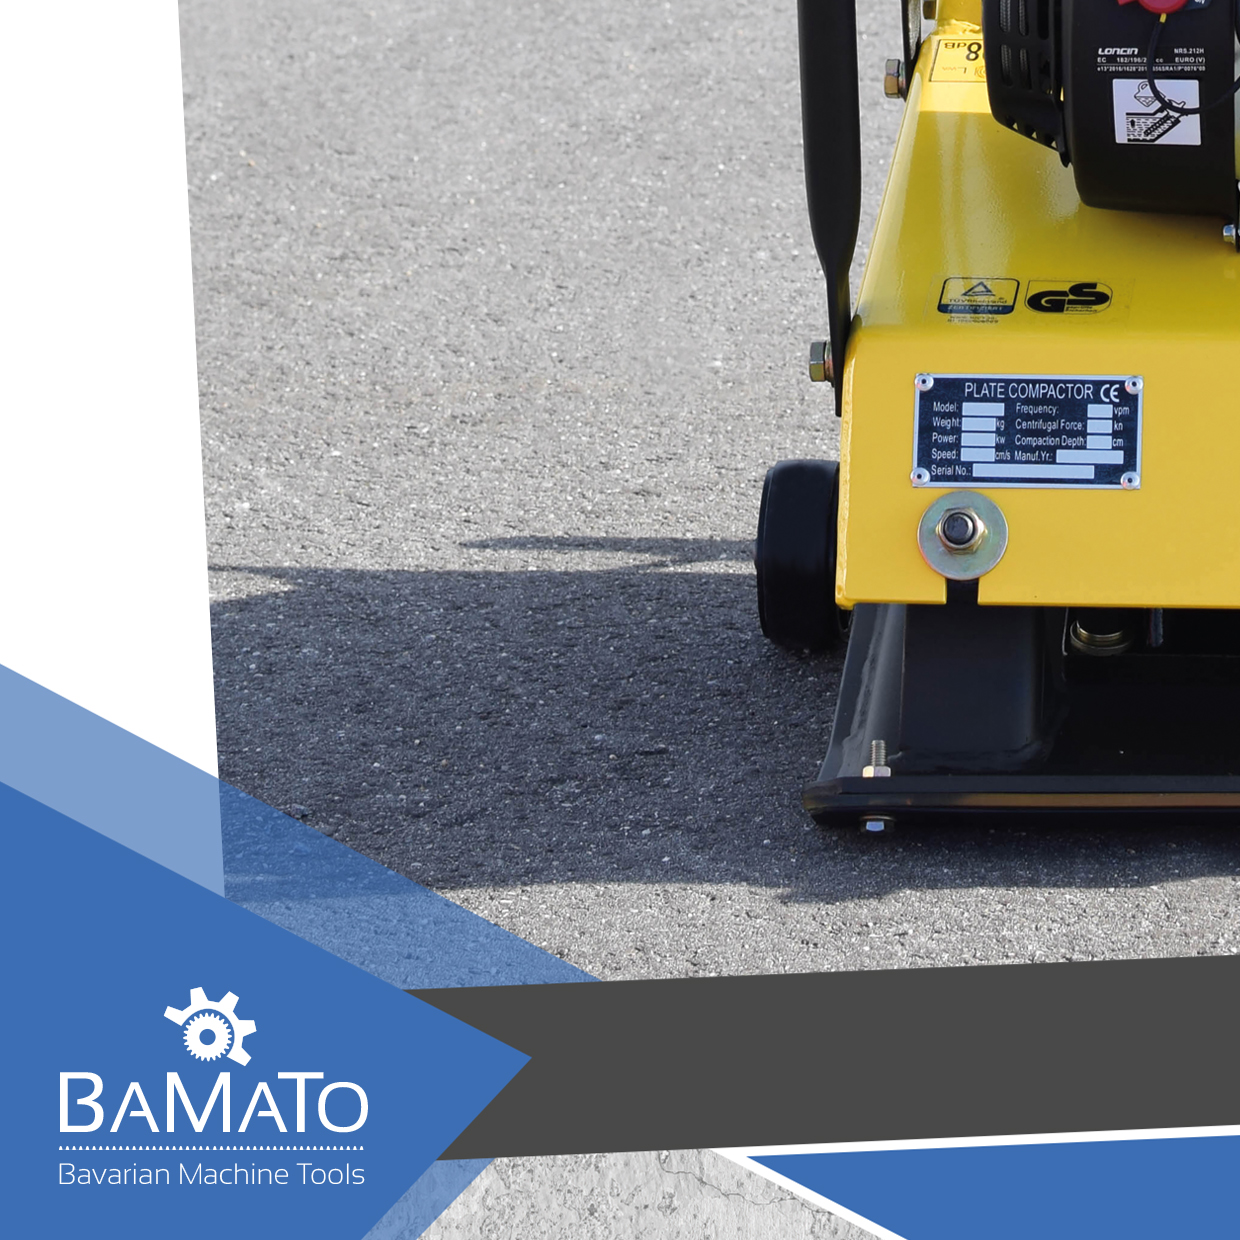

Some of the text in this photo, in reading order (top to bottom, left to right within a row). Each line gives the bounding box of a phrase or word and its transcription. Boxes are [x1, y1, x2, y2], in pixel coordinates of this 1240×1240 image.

[1098, 47, 1139, 56] LONCIN
[1097, 56, 1107, 64] EC
[1175, 56, 1195, 64] EURO
[1195, 56, 1206, 65] (V)
[964, 382, 1005, 398] PLATE
[1008, 383, 1093, 399] COMPACTOR
[933, 401, 959, 412] Model:
[1016, 402, 1130, 416] Frequency: vpm
[932, 416, 1005, 429] Weight: kg
[1015, 418, 1124, 432] Centrifugal Force: kn
[932, 433, 959, 443] Power:
[1015, 434, 1124, 447] Compaction Depth: cm
[931, 449, 1011, 461] Speed: cm/s
[931, 464, 971, 477] Serial No.:
